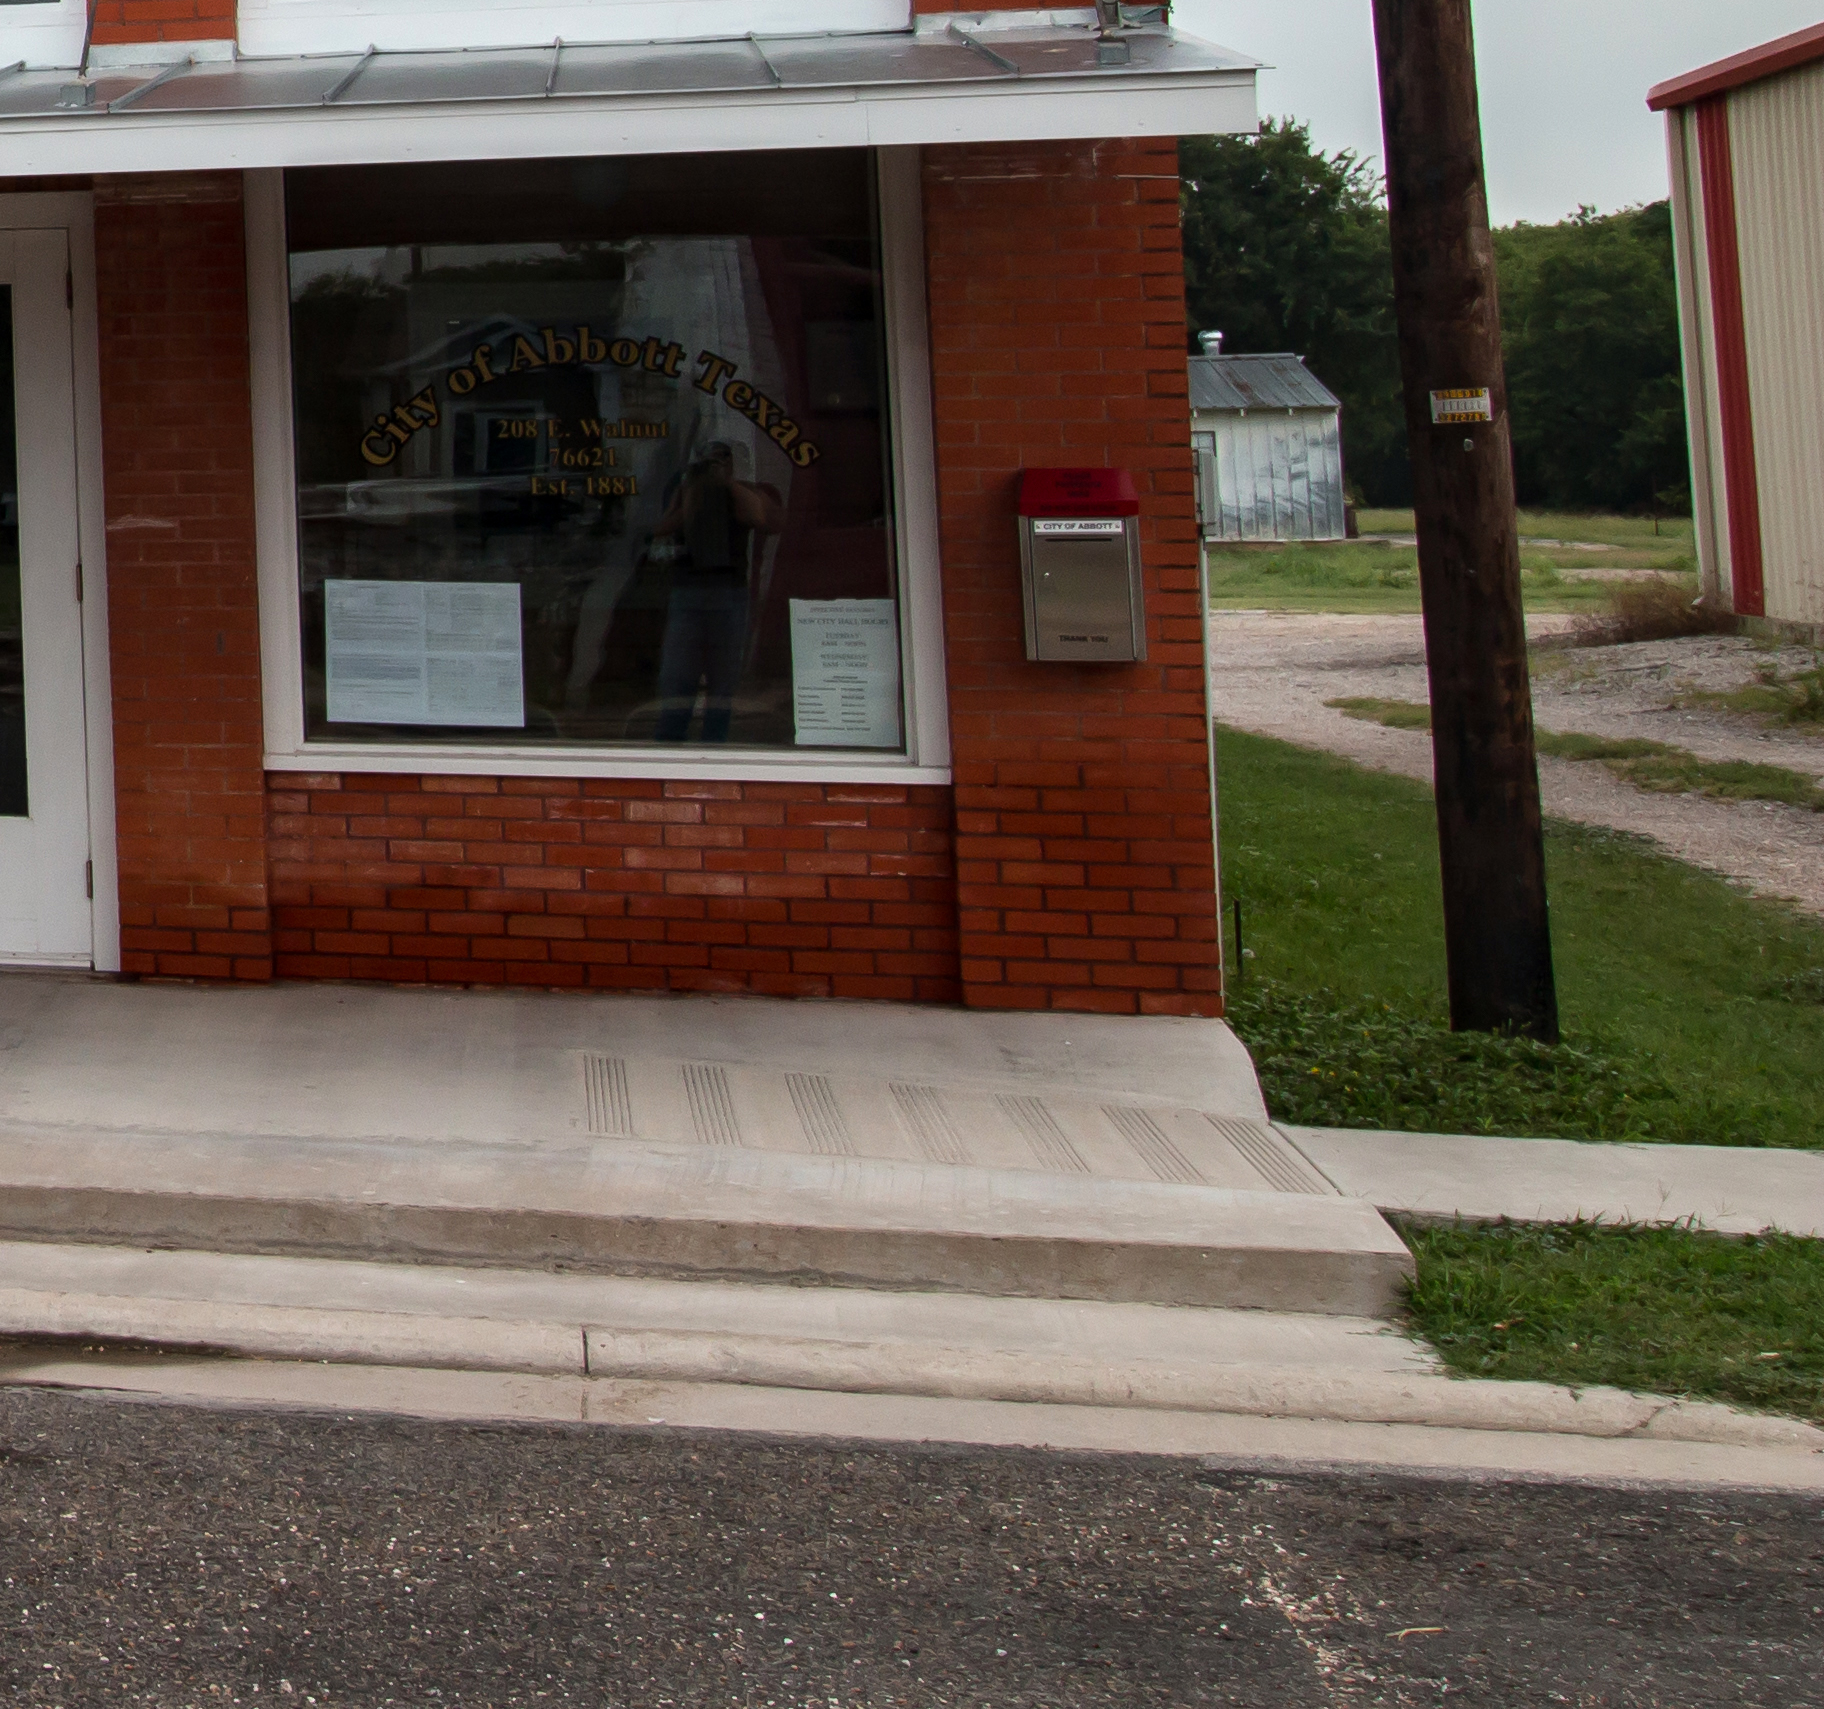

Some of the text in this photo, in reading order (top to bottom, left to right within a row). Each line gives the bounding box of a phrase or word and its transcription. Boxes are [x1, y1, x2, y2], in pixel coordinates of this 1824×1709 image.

[360, 326, 821, 468] City of Abbott Texas
[497, 418, 670, 439] 208 E. Walnut
[549, 447, 617, 467] 76621
[530, 476, 638, 496] Est. 1881
[1042, 522, 1113, 531] CITY OF ABBOTT
